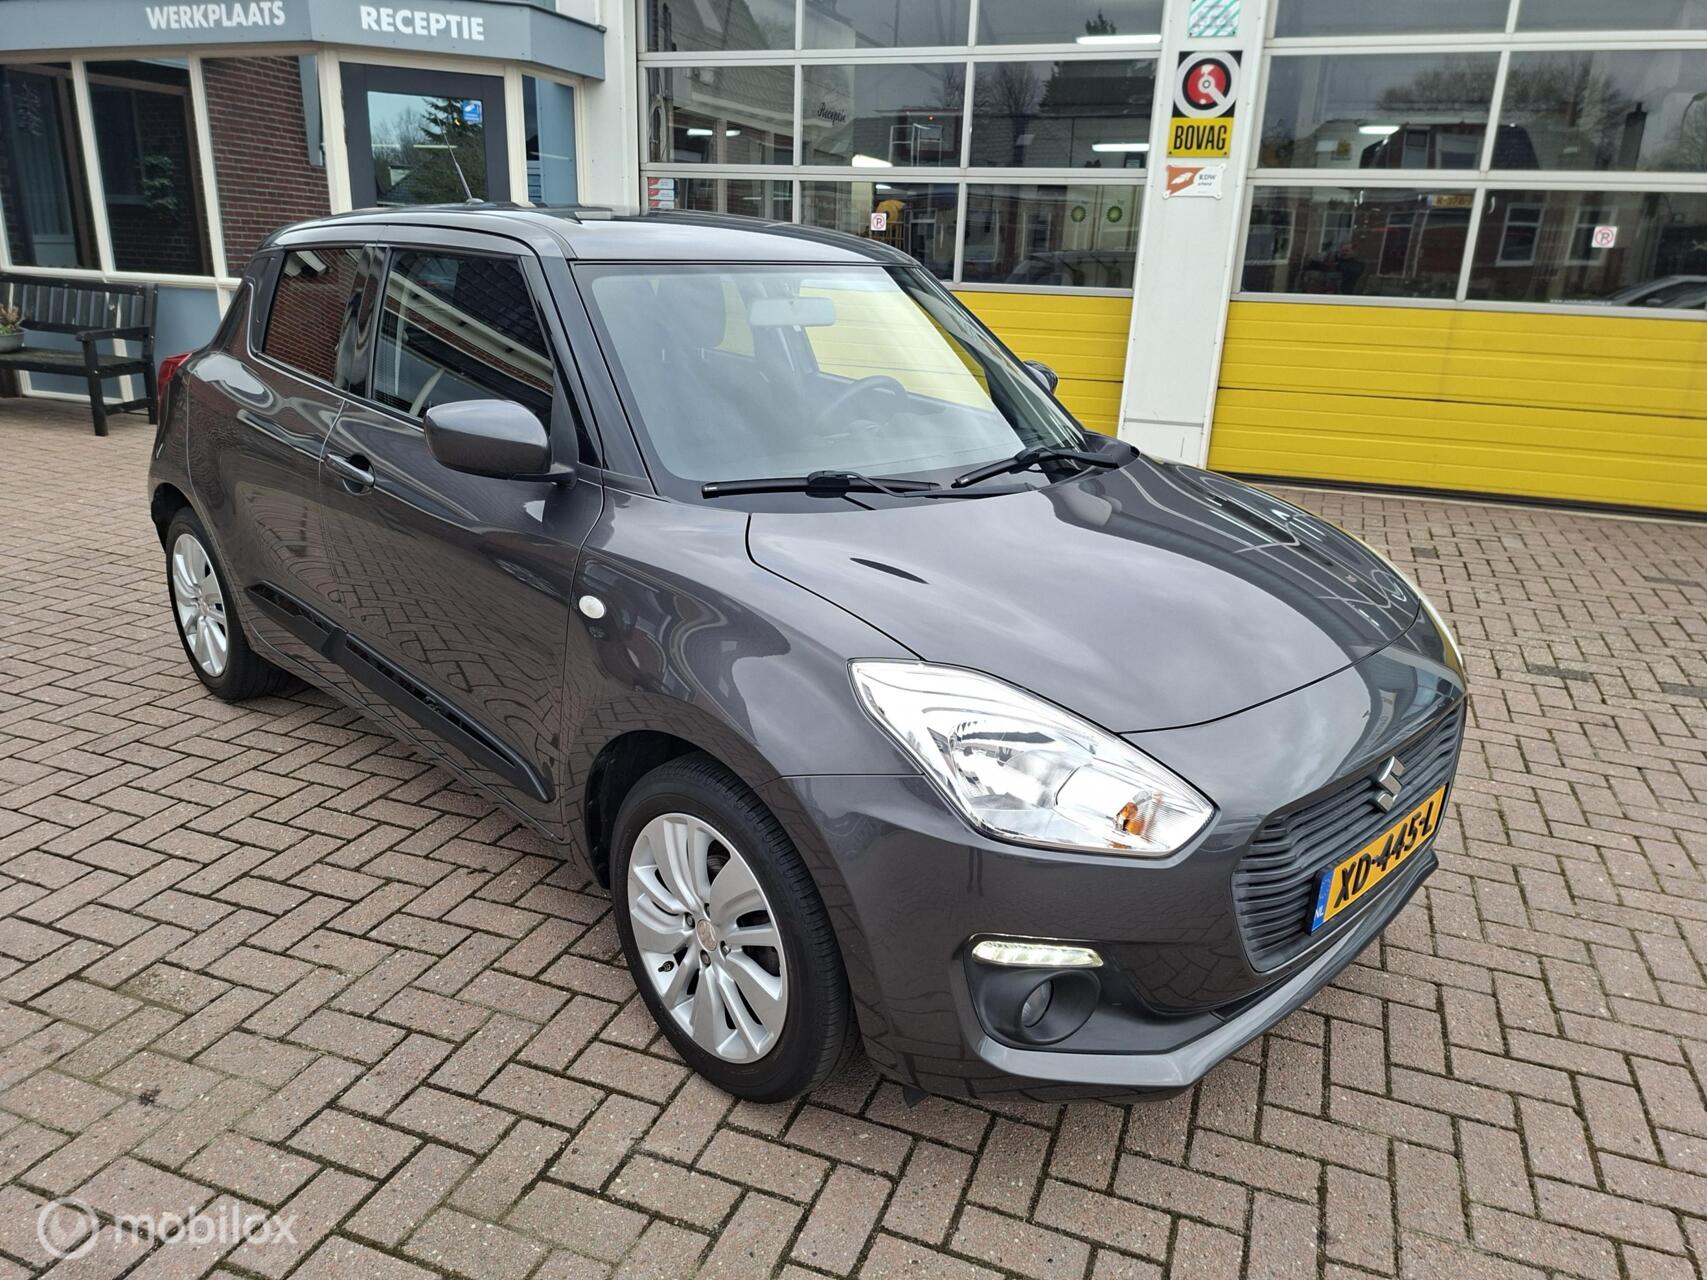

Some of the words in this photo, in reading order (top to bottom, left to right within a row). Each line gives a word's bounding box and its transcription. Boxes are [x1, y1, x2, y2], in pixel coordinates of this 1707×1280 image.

[145, 1, 286, 30] WERKPLAATS
[360, 5, 485, 41] RECEPTIE
[1173, 124, 1228, 151] BOVAG
[1333, 801, 1434, 908] XD-445-L
